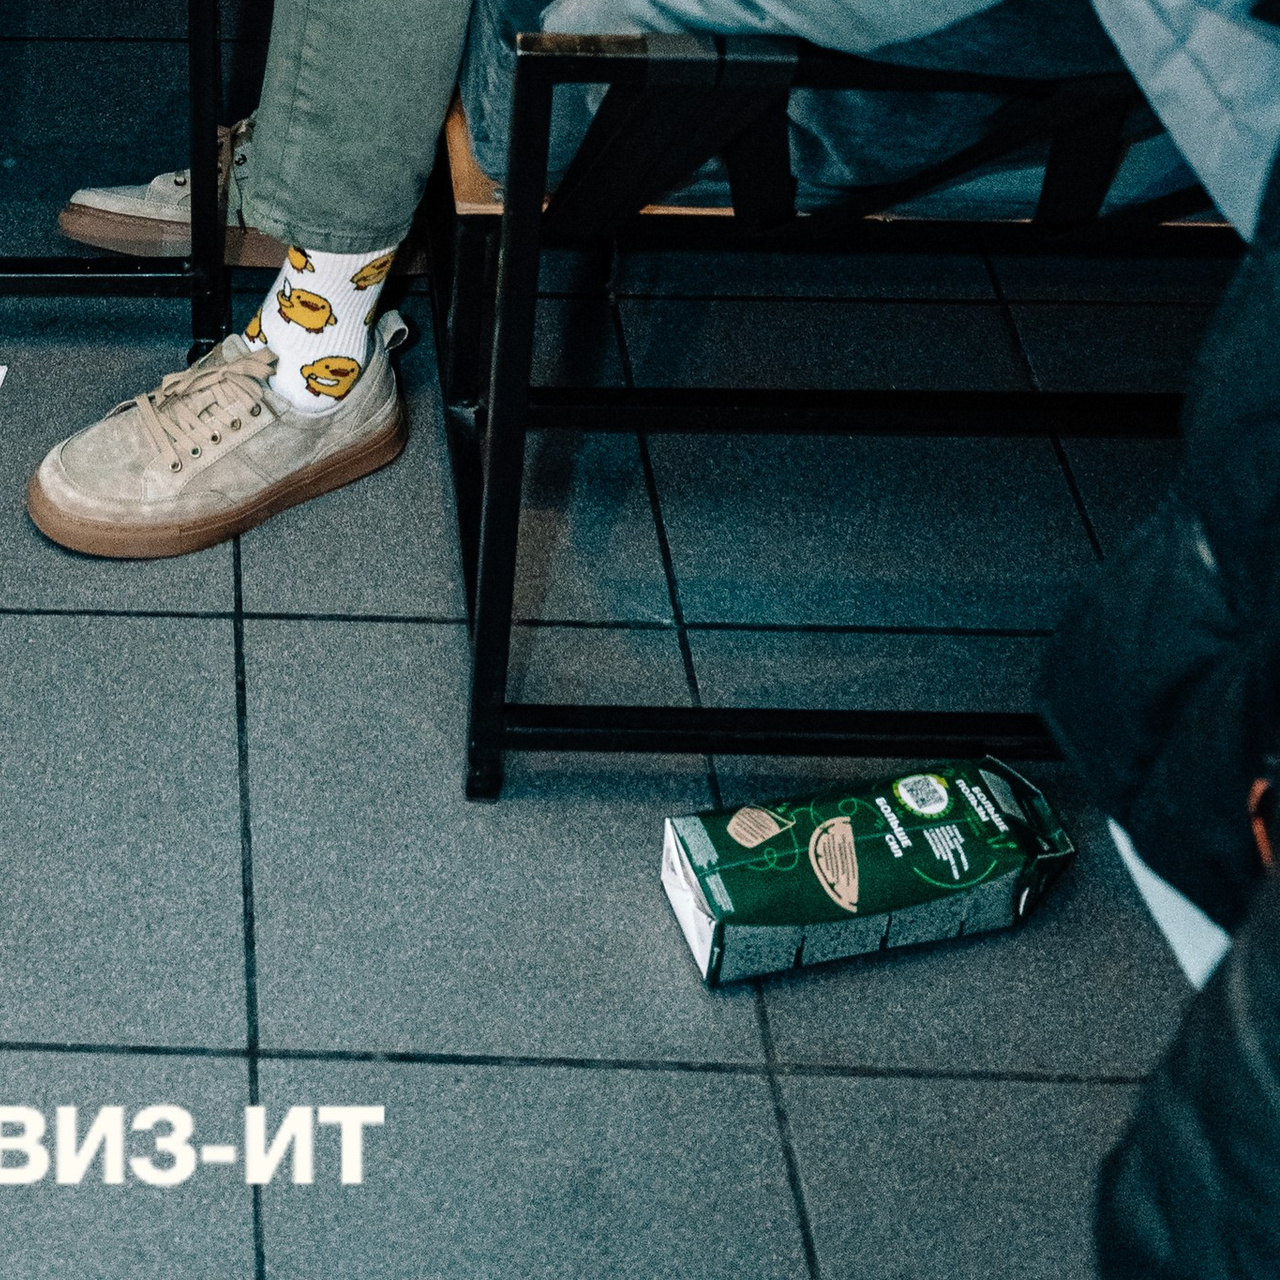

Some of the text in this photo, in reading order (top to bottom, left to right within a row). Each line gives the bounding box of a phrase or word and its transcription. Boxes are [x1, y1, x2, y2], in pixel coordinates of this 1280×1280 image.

[875, 797, 913, 848] БОЛЬШЕ
[955, 779, 989, 822] ПОЛЬЗЫ
[971, 786, 1009, 832] БОЛЬШЕ
[885, 834, 903, 858] СИЛ
